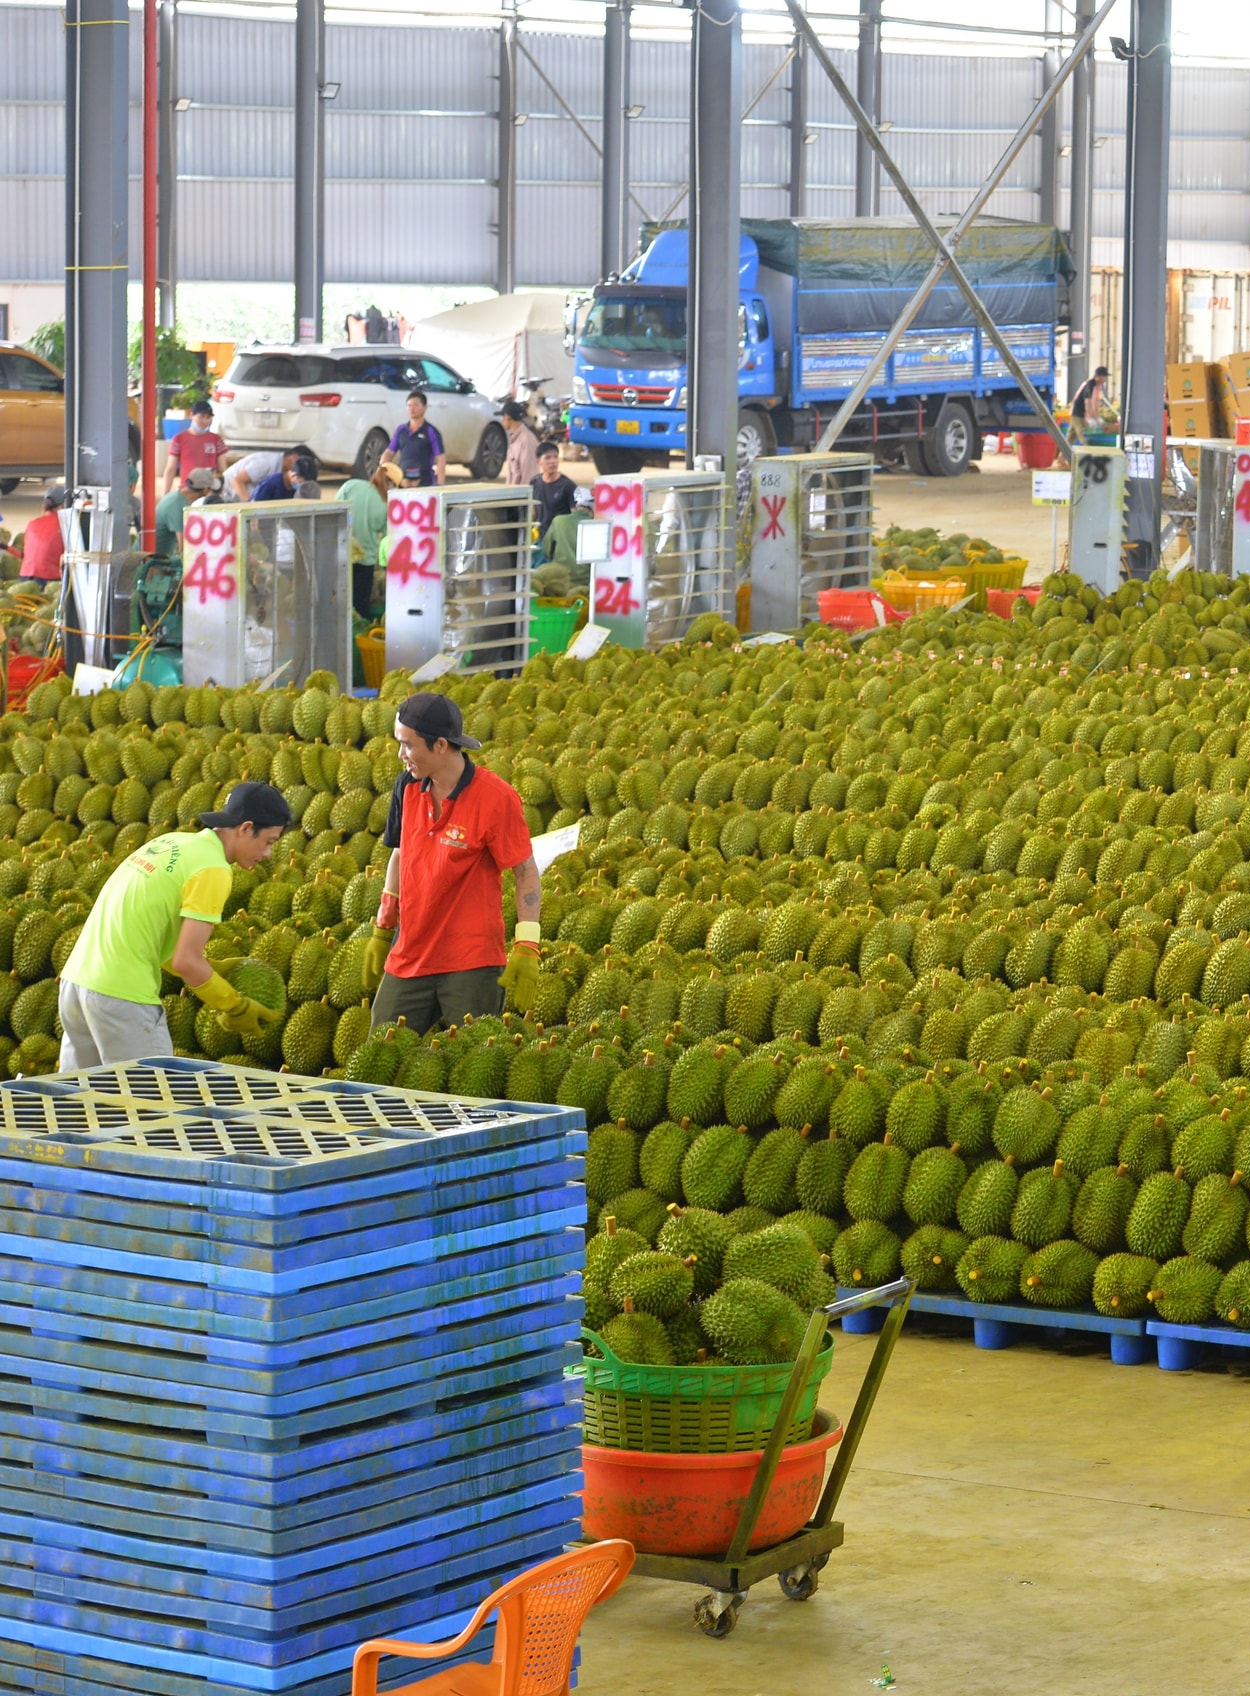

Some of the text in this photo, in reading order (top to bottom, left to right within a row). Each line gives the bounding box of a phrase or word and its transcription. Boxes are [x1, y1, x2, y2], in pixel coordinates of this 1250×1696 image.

[1207, 297, 1232, 310] PIL
[184, 514, 238, 548] 001
[388, 496, 440, 532] 001
[183, 553, 237, 604] 46
[387, 536, 442, 585] 42
[595, 578, 640, 616] 24
